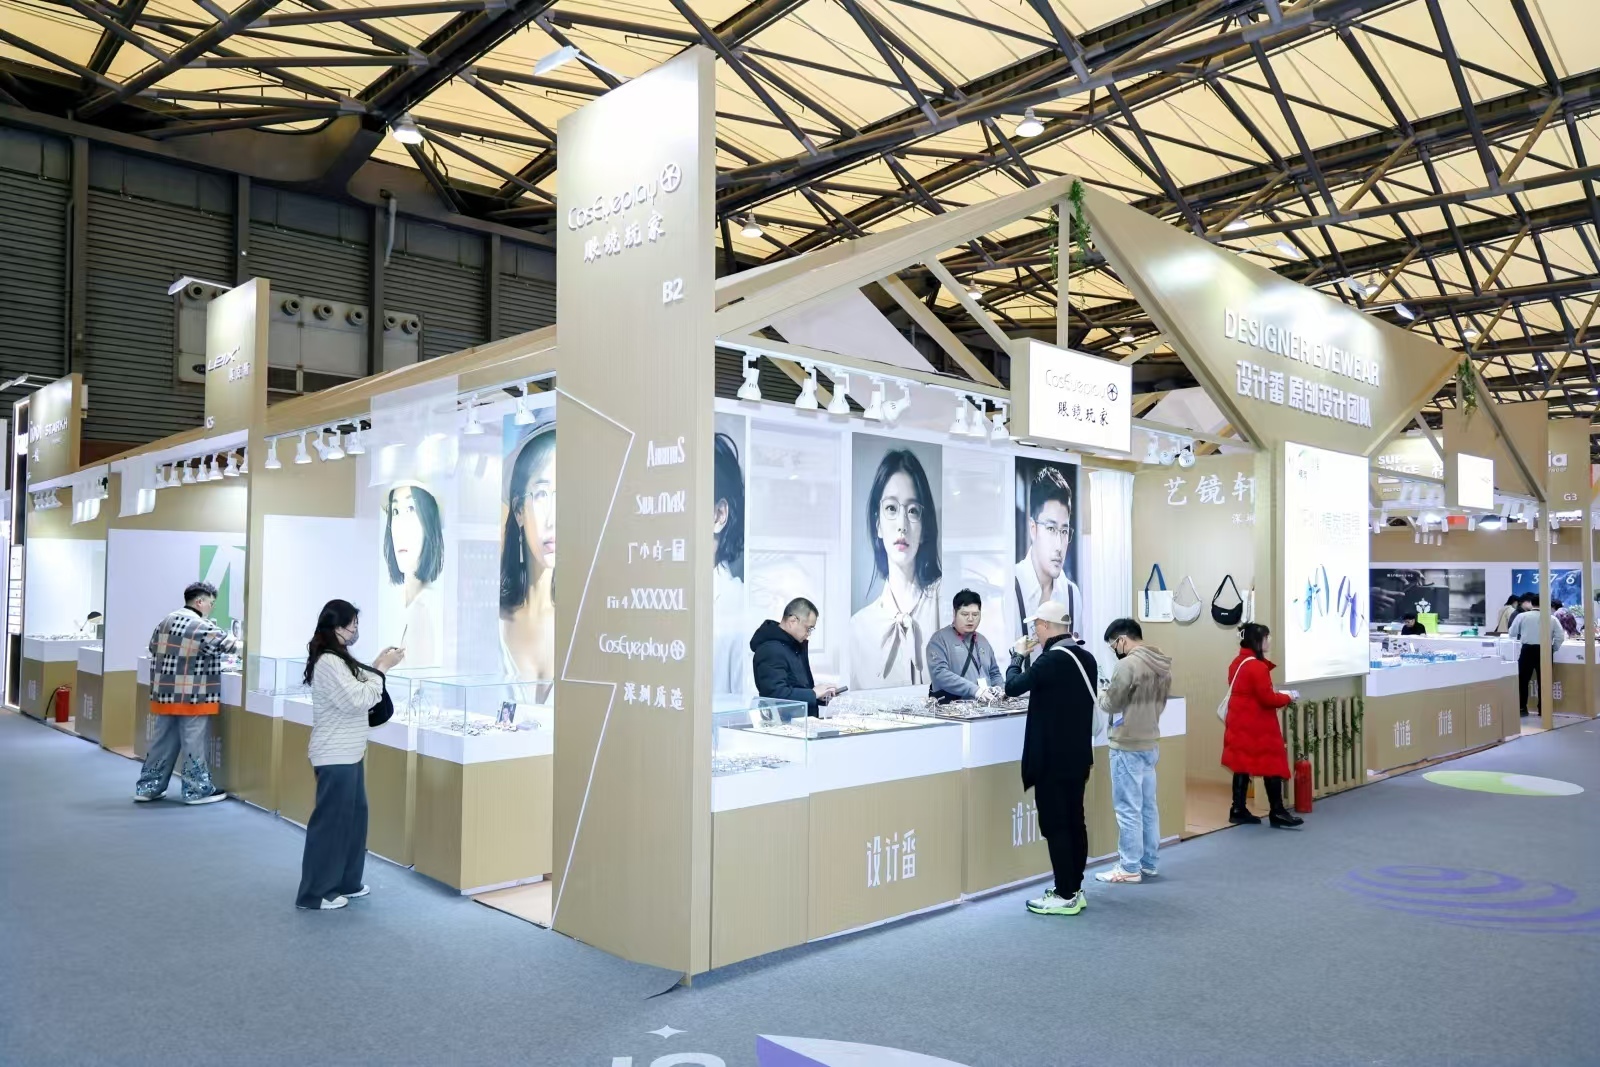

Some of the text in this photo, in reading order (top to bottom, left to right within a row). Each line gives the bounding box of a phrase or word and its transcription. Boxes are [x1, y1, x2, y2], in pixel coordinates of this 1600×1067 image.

[662, 278, 684, 304] B2
[1224, 307, 1380, 387] DESIGNER EYEWEAR
[1236, 360, 1372, 429] 设计番 原创设计团队
[1164, 471, 1257, 506] 艺镜轩
[1563, 493, 1578, 501] G3
[599, 633, 669, 663] CosEyeplay
[1012, 799, 1049, 848] 设计
[866, 828, 917, 888] 设计番
